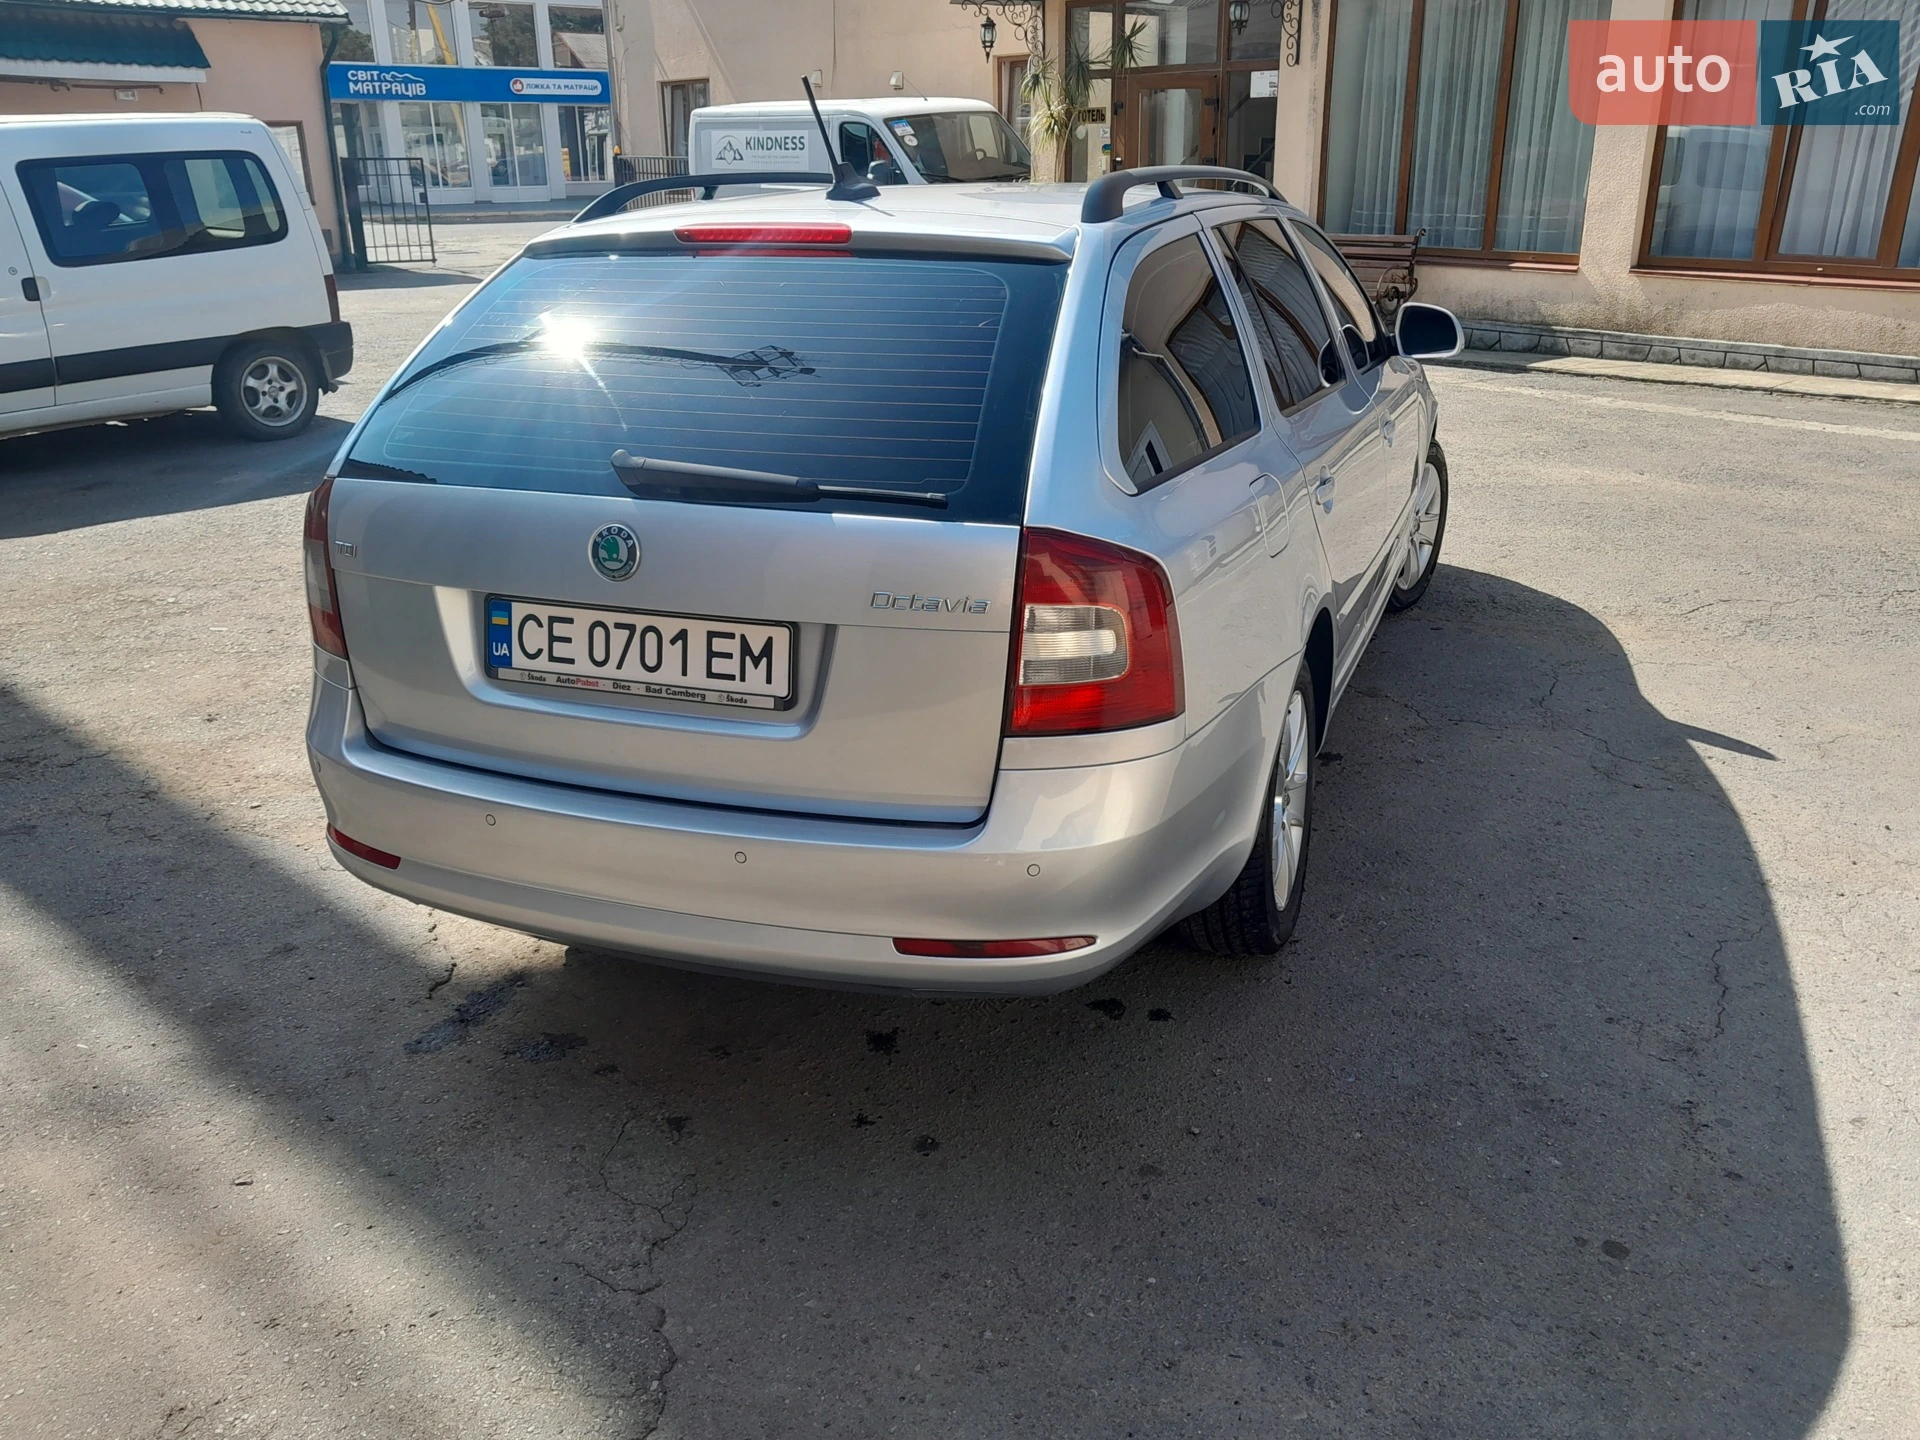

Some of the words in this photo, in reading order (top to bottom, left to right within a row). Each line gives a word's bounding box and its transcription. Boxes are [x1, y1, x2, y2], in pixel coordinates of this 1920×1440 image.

[347, 70, 379, 81] СВІТ
[348, 81, 427, 98] МАТРАЦІВ
[526, 83, 550, 91] ЛІЖКА
[553, 83, 562, 91] ТА
[563, 83, 598, 92] МАТРАЦИ
[1077, 109, 1106, 122] ГОТЕЛЬ
[745, 136, 805, 151] KINDNESS
[870, 591, 992, 614] Octavia
[492, 641, 510, 657] UA
[518, 613, 575, 665] CE
[588, 620, 689, 677] 0701
[706, 630, 774, 685] EM
[556, 676, 600, 688] AutoPabst
[612, 682, 631, 691] Diez
[645, 685, 663, 695] Bad
[665, 688, 706, 702] Camberg
